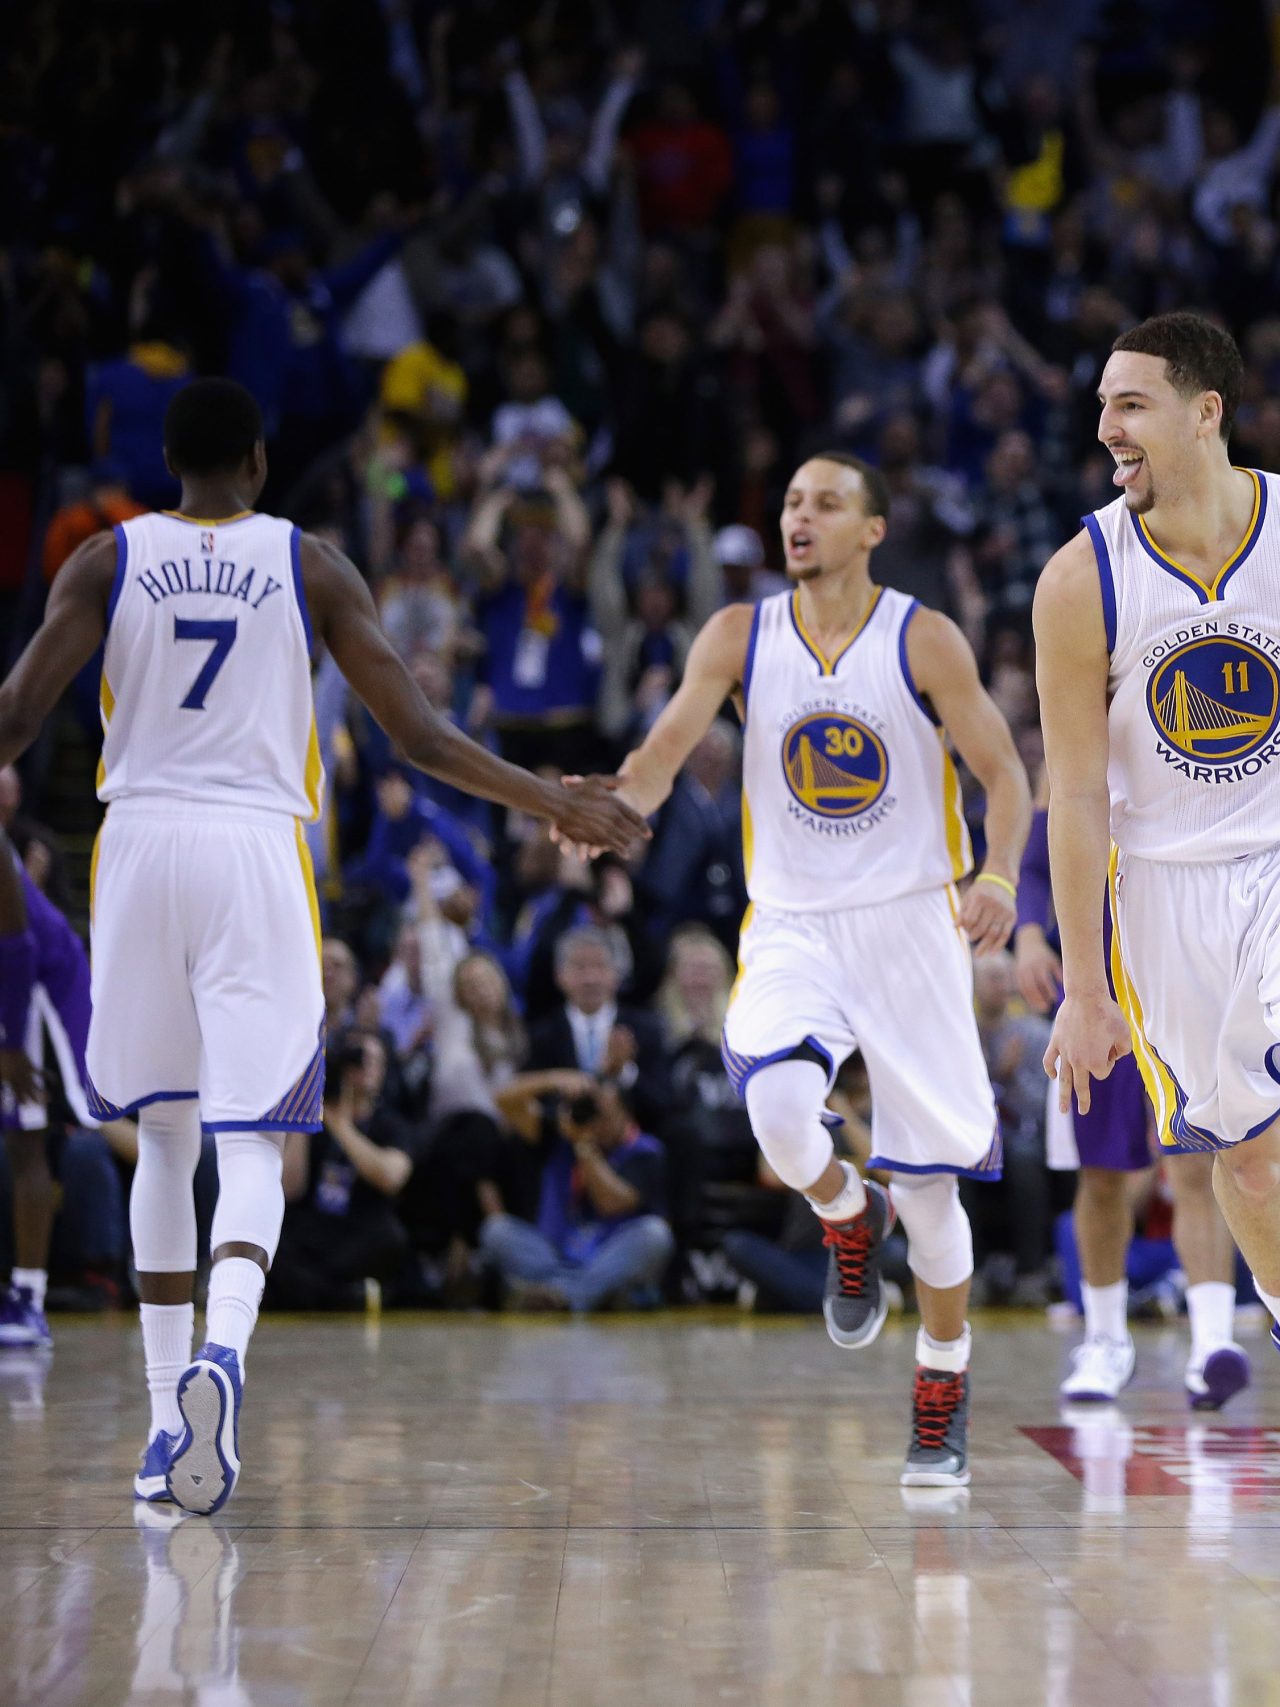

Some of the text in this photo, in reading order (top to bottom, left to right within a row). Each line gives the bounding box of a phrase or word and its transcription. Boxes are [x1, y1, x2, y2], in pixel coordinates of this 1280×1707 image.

[136, 557, 282, 610] HOLIDAY
[174, 613, 238, 711] 7
[1143, 621, 1218, 669] GOLDEN
[1221, 660, 1250, 695] 11
[843, 702, 888, 732] STATE
[824, 726, 865, 758] 30
[787, 795, 898, 838] WARRIORS
